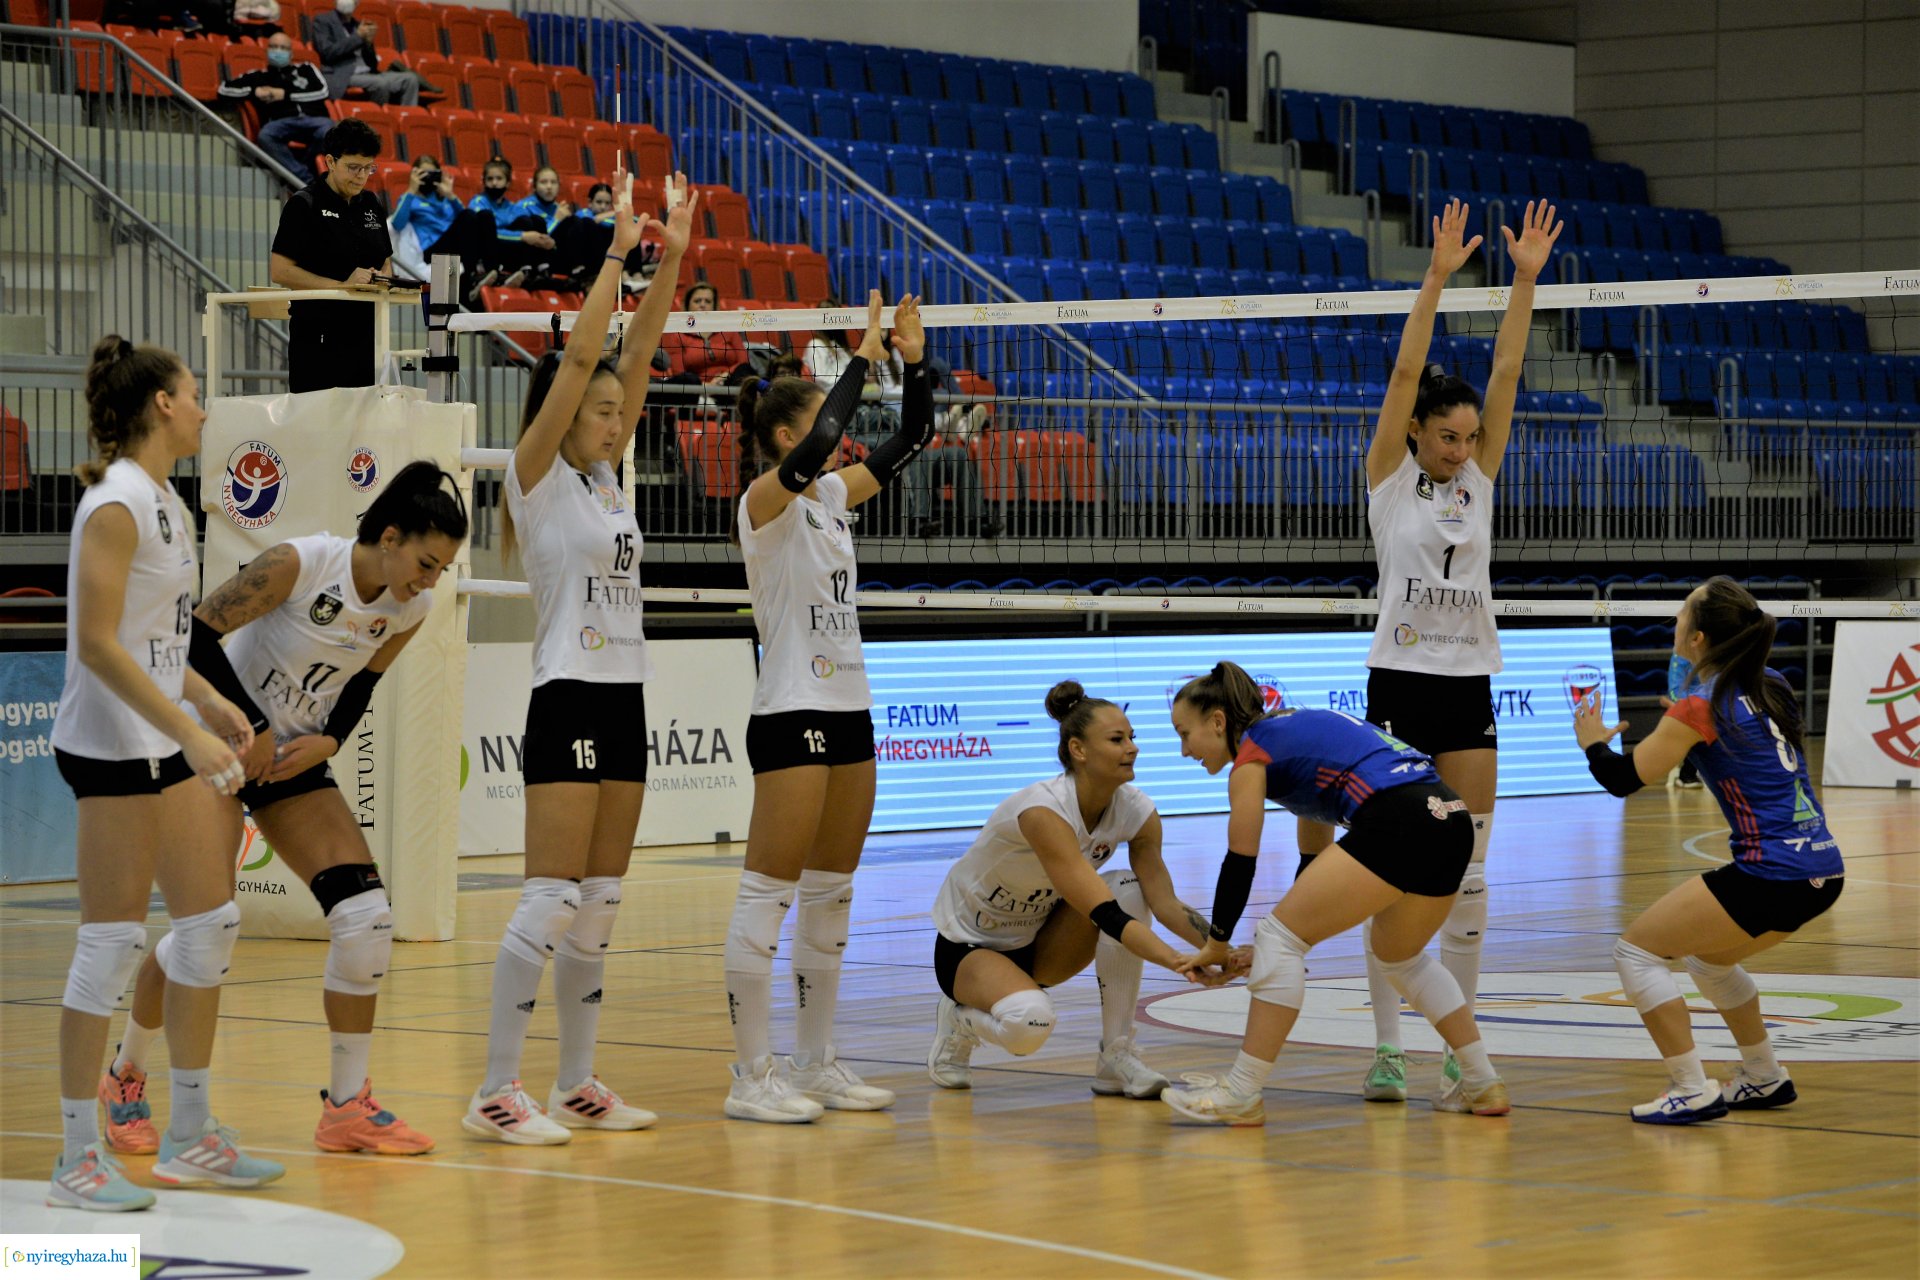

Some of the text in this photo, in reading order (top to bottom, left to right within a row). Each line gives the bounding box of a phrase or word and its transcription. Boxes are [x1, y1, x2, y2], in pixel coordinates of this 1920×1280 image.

[1315, 298, 1349, 310] FATUM
[1589, 288, 1625, 301] FATUM
[823, 312, 852, 324] FATUM
[1057, 306, 1089, 318] FATUM
[249, 443, 281, 467] FATUM
[224, 485, 276, 528] NYÍREGYHÁZA
[614, 533, 634, 572] 15
[1442, 545, 1456, 579] 1
[830, 569, 852, 605] 12
[1402, 577, 1484, 608] FATUM
[989, 597, 1014, 607] FATUM
[1237, 601, 1263, 611] FATUM
[1504, 603, 1532, 613] FATUM
[1792, 604, 1822, 615] FATUM
[808, 605, 860, 631] FATU
[302, 662, 341, 693] 17
[1329, 690, 1368, 711] FATU
[1490, 689, 1534, 718] VTK
[887, 703, 959, 728] FATUM
[804, 729, 826, 753] 12
[874, 732, 992, 762] YÍREGYHÁZA
[572, 739, 596, 770] 15
